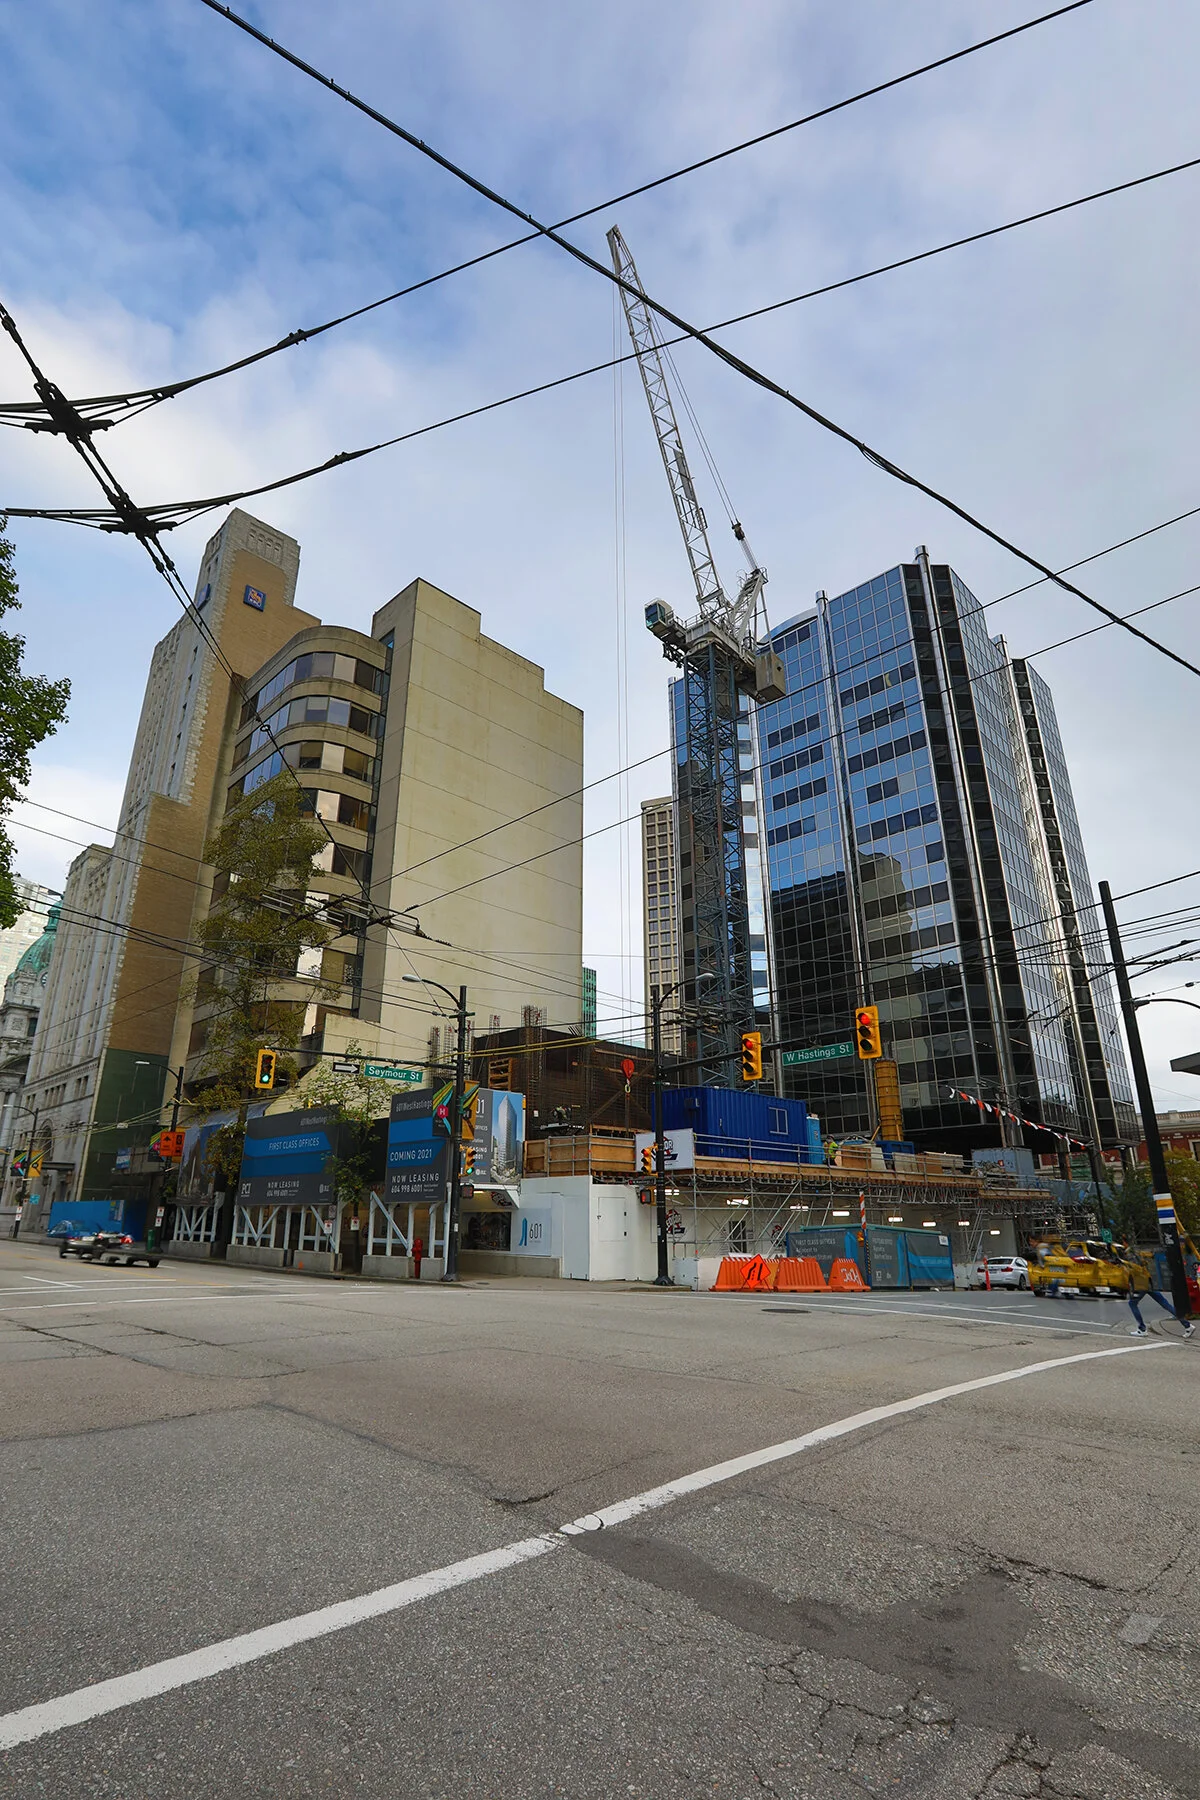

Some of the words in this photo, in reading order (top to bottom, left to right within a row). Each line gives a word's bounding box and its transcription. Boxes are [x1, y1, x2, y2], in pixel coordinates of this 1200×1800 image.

[786, 1053, 795, 1062] W
[798, 1047, 836, 1060] Hastings
[839, 1044, 850, 1054] St
[368, 1066, 407, 1079] Seymour
[409, 1072, 420, 1080] St
[268, 1142, 282, 1150] FIRST
[283, 1140, 298, 1149] CLASS
[299, 1137, 320, 1147] OFFICES
[390, 1150, 416, 1161] COMING
[418, 1149, 432, 1160] 2021
[279, 1180, 300, 1189] LEASING
[392, 1175, 406, 1184] NOW
[409, 1173, 440, 1183] LEASING
[391, 1185, 400, 1193] 604
[401, 1185, 410, 1193] 998
[410, 1184, 423, 1193] 6001
[529, 1223, 542, 1239] 601
